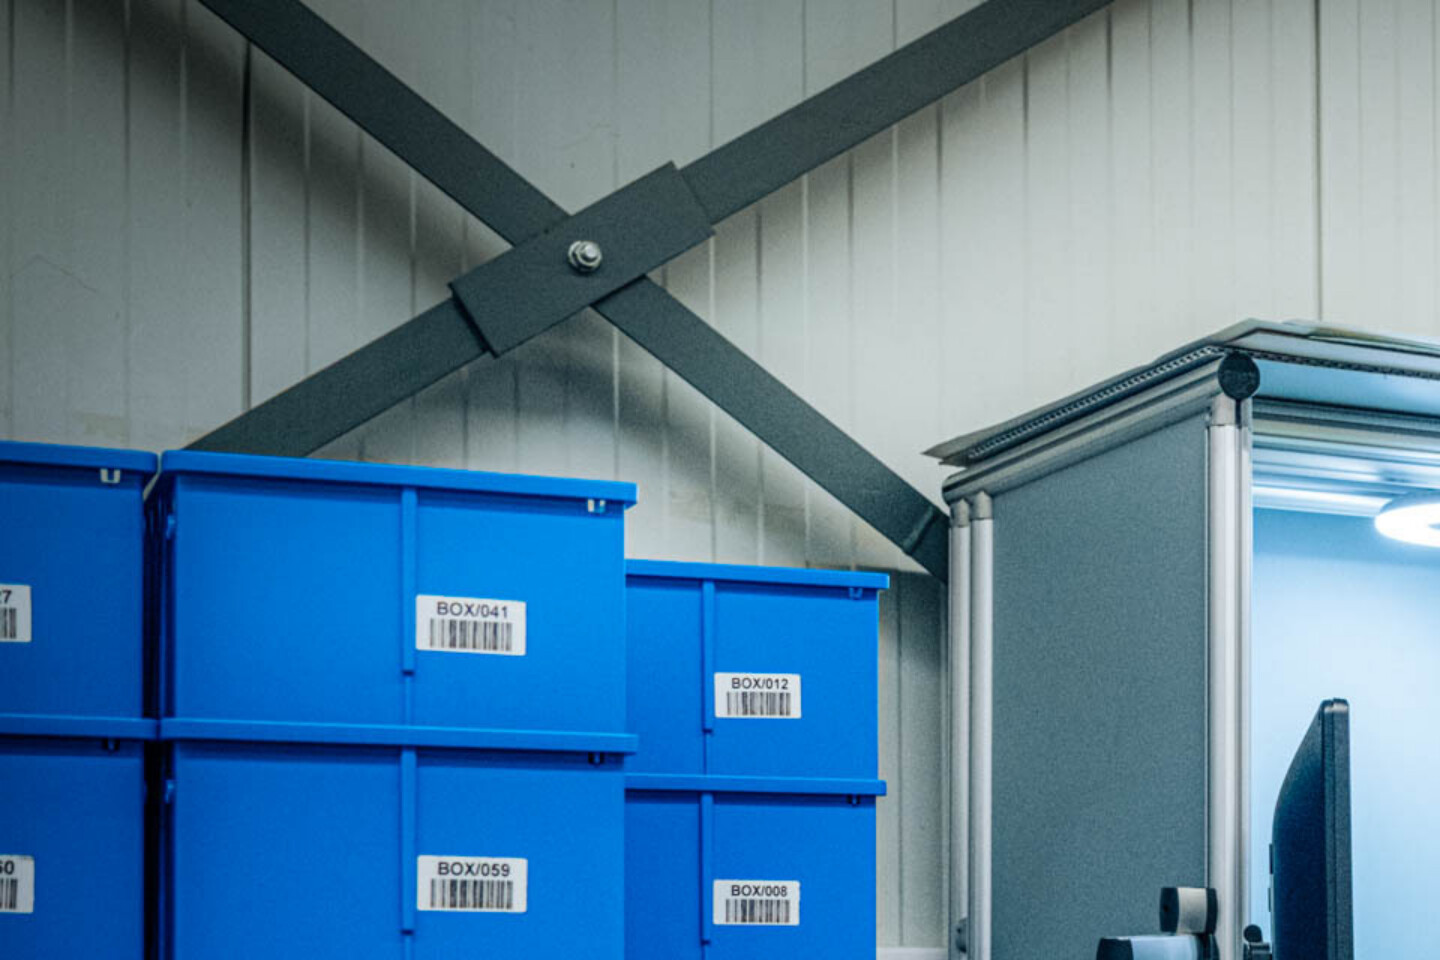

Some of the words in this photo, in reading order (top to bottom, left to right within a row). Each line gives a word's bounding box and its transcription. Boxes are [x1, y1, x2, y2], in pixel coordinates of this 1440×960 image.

[437, 601, 509, 619] BOX/041
[731, 677, 789, 690] BOX/012
[437, 861, 510, 876] BOX/059
[731, 884, 788, 898] BOX/008
